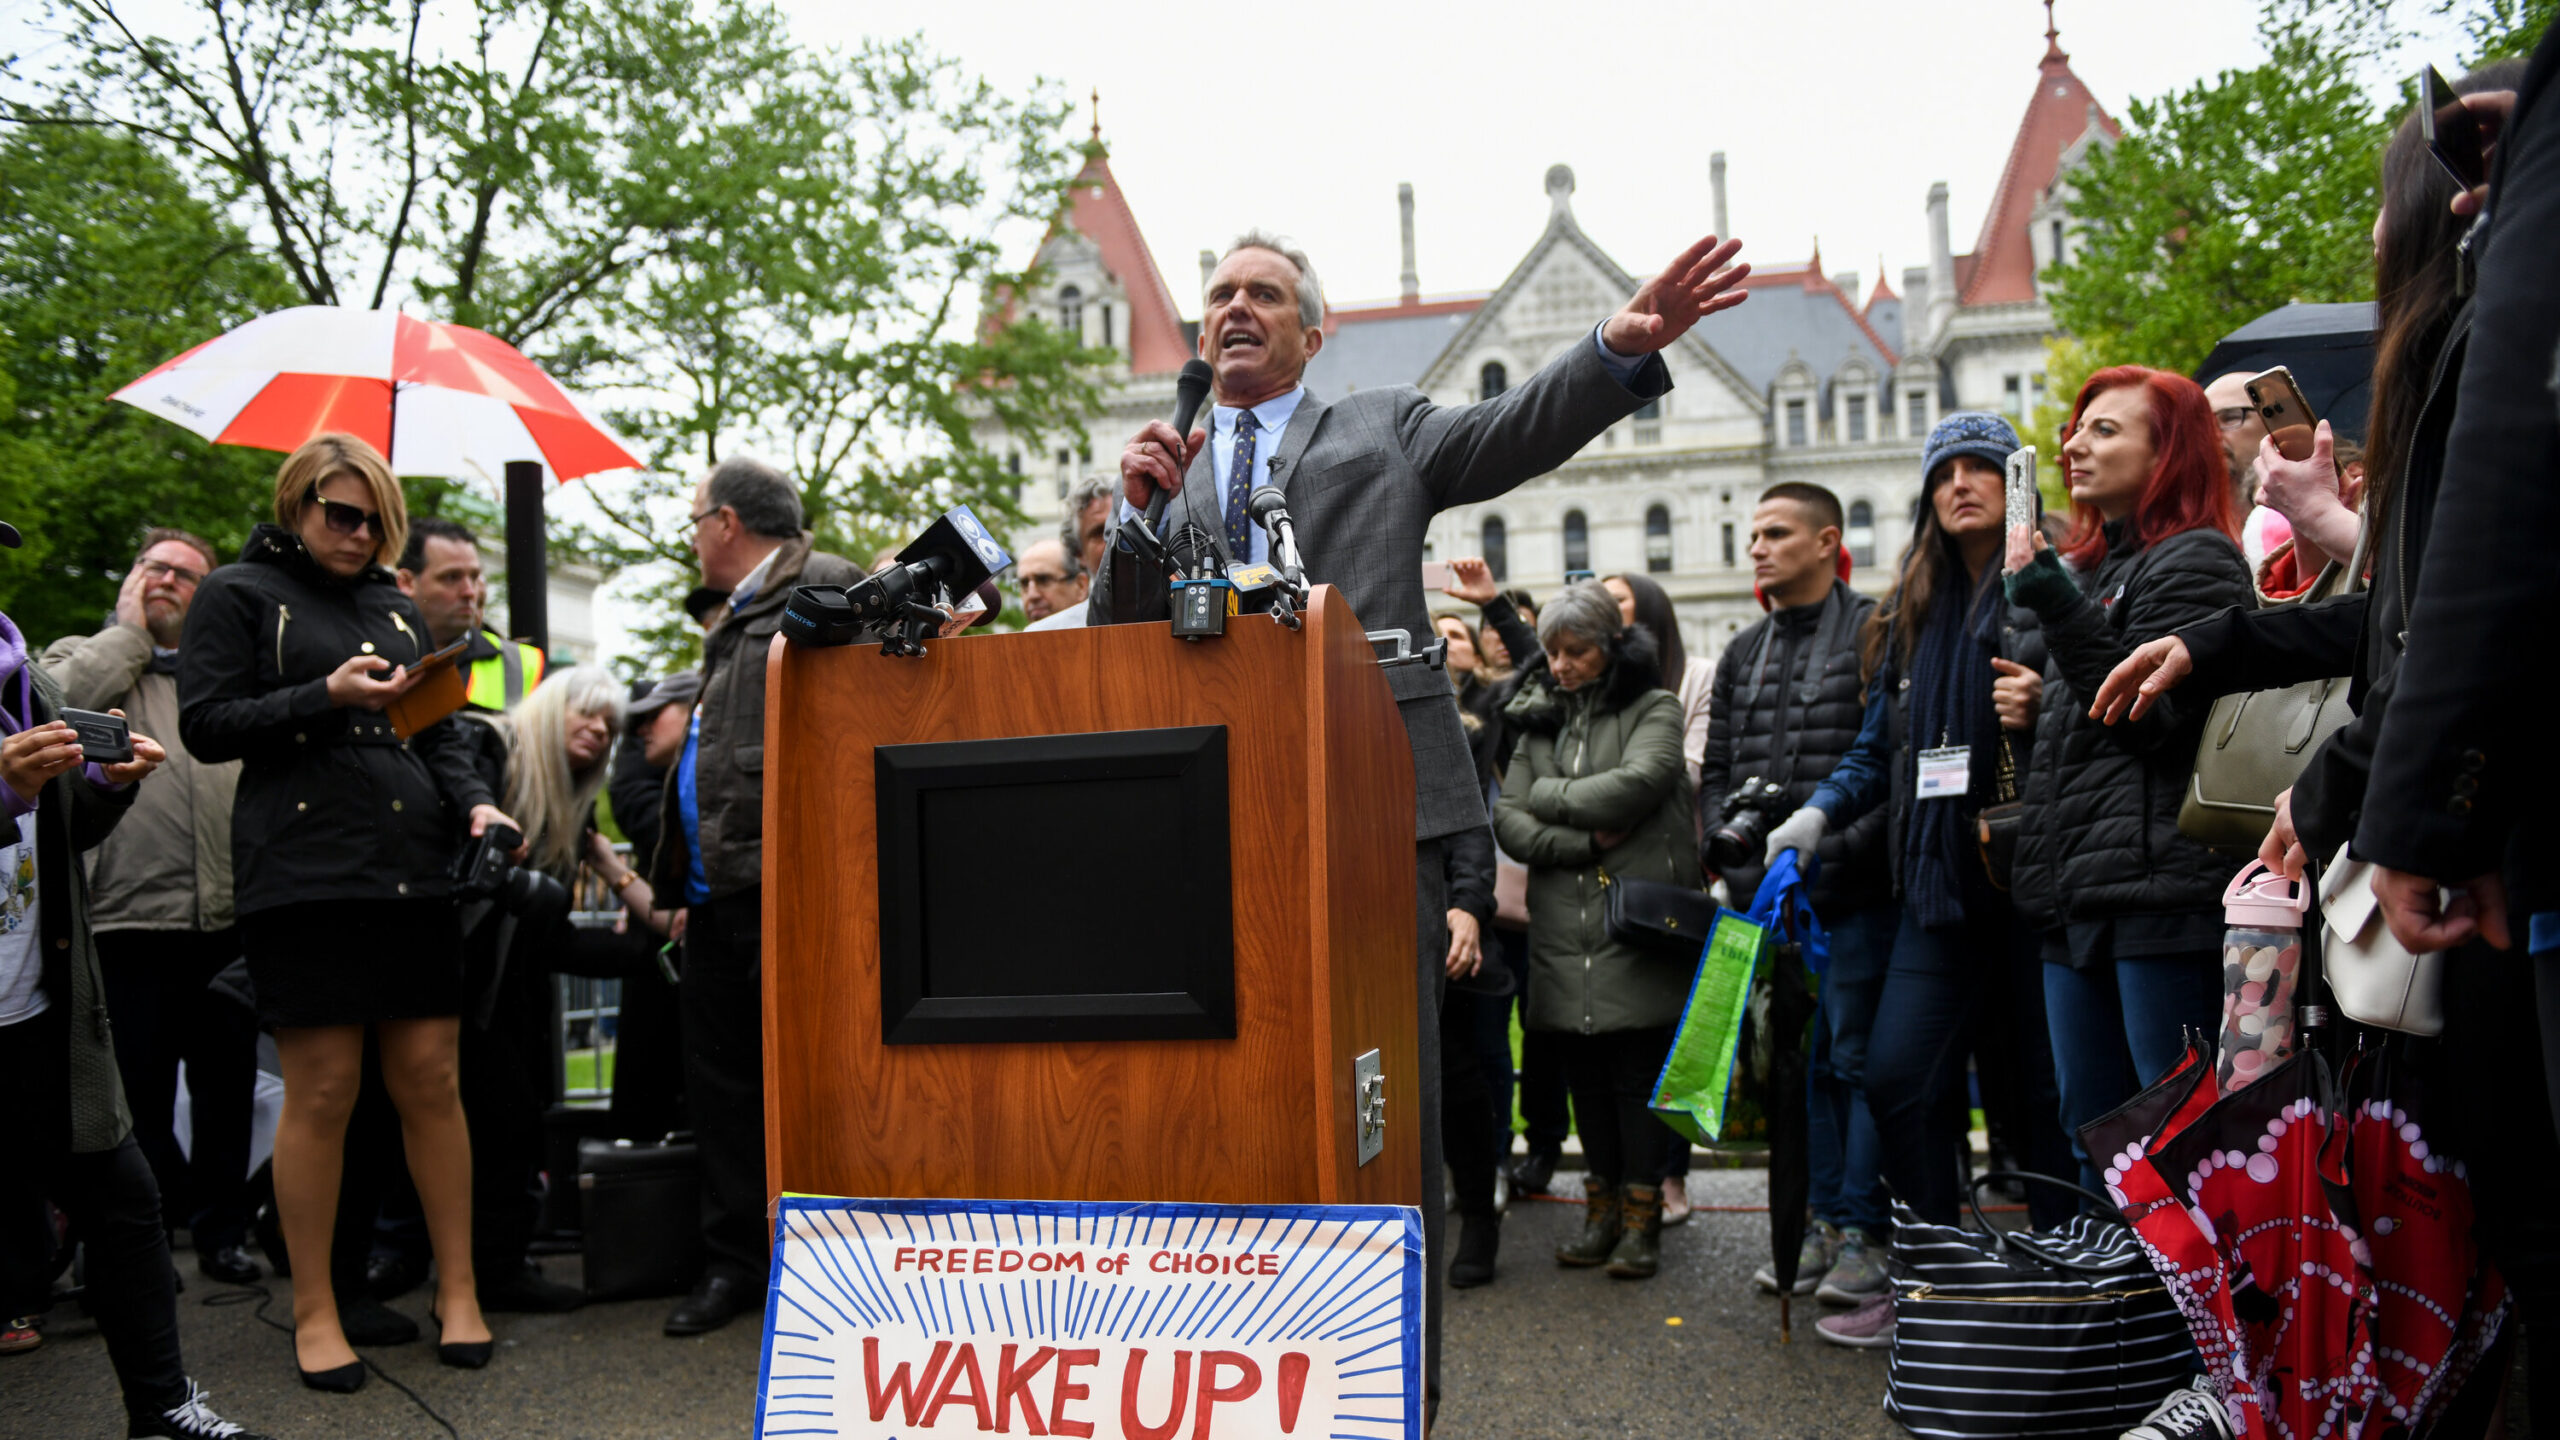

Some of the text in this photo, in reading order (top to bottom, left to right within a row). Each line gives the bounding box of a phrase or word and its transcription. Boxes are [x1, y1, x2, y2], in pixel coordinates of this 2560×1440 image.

[978, 538, 1001, 563] 6
[895, 1248, 1278, 1275] FREEDOM of CHOICE
[863, 1337, 1100, 1437] WAKE
